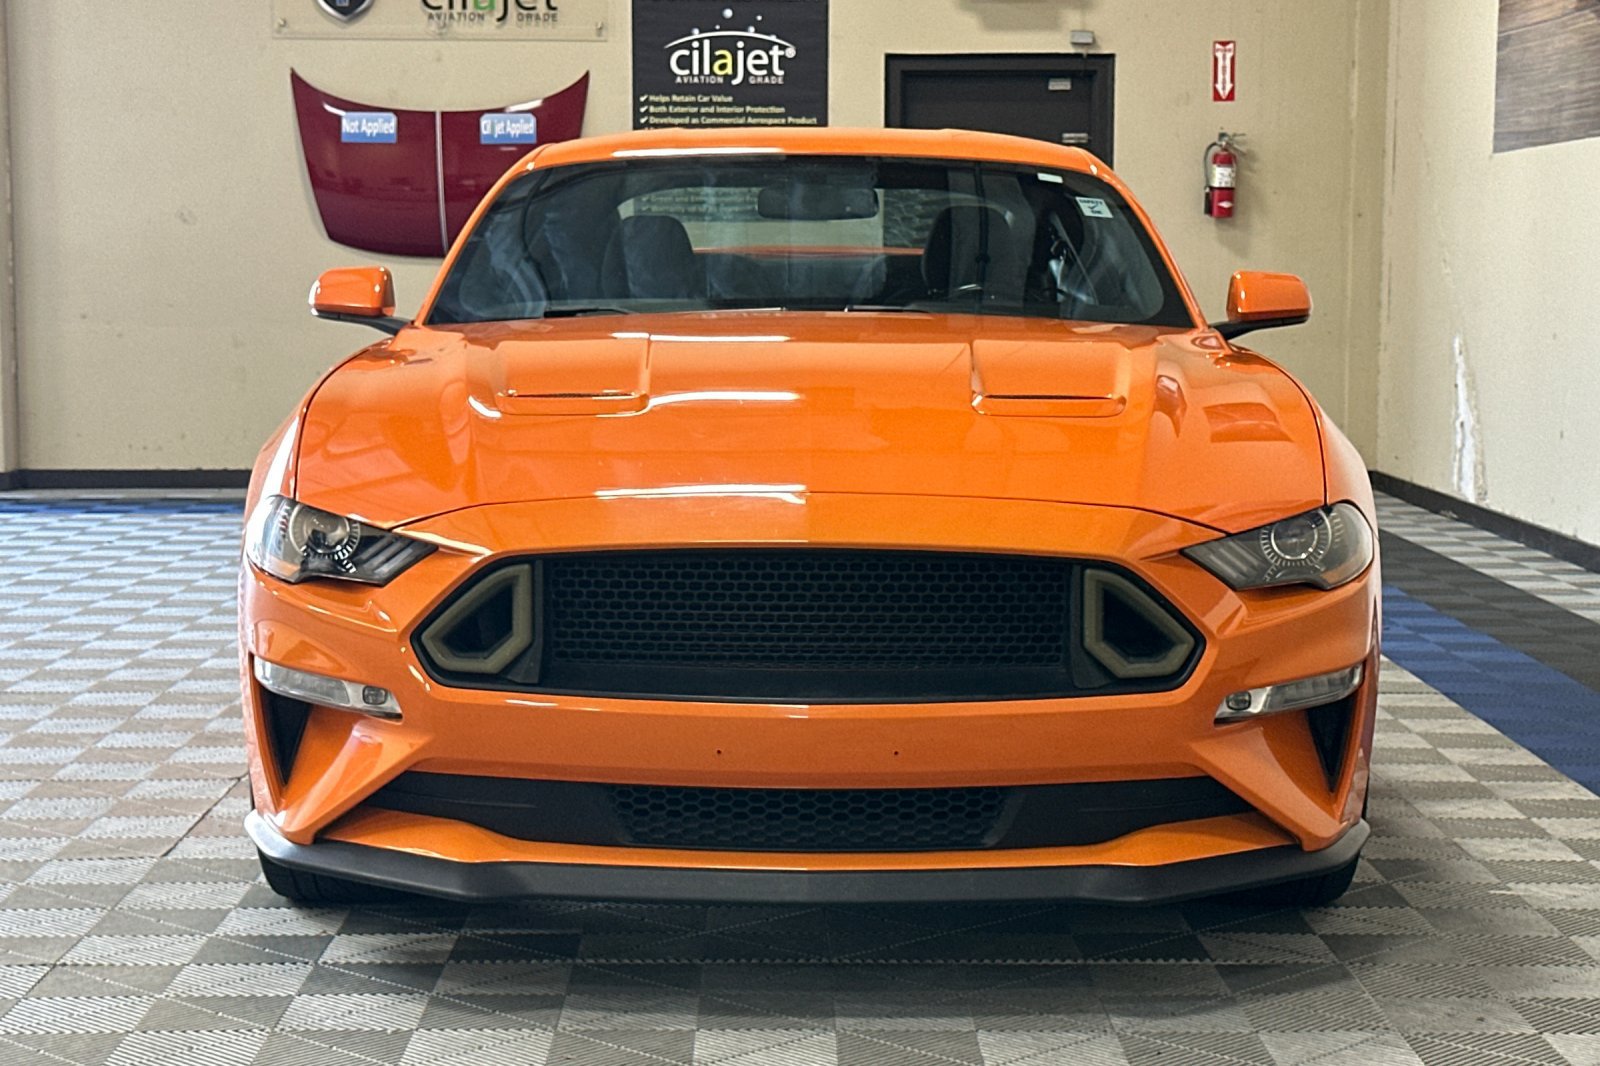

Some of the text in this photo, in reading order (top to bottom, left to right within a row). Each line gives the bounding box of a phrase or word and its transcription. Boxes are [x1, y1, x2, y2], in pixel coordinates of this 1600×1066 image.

[428, 12, 558, 22] AVIATION GRADE
[670, 39, 785, 85] cilajet
[675, 76, 784, 84] AVIATION GRADE
[649, 94, 733, 103] Helps Retain Car Value
[649, 116, 690, 125] Developed
[701, 116, 745, 124] Commercial
[747, 116, 786, 125] Aerospace
[787, 116, 817, 124] Product
[342, 117, 395, 137] Not Applied
[505, 119, 534, 138] Applied
